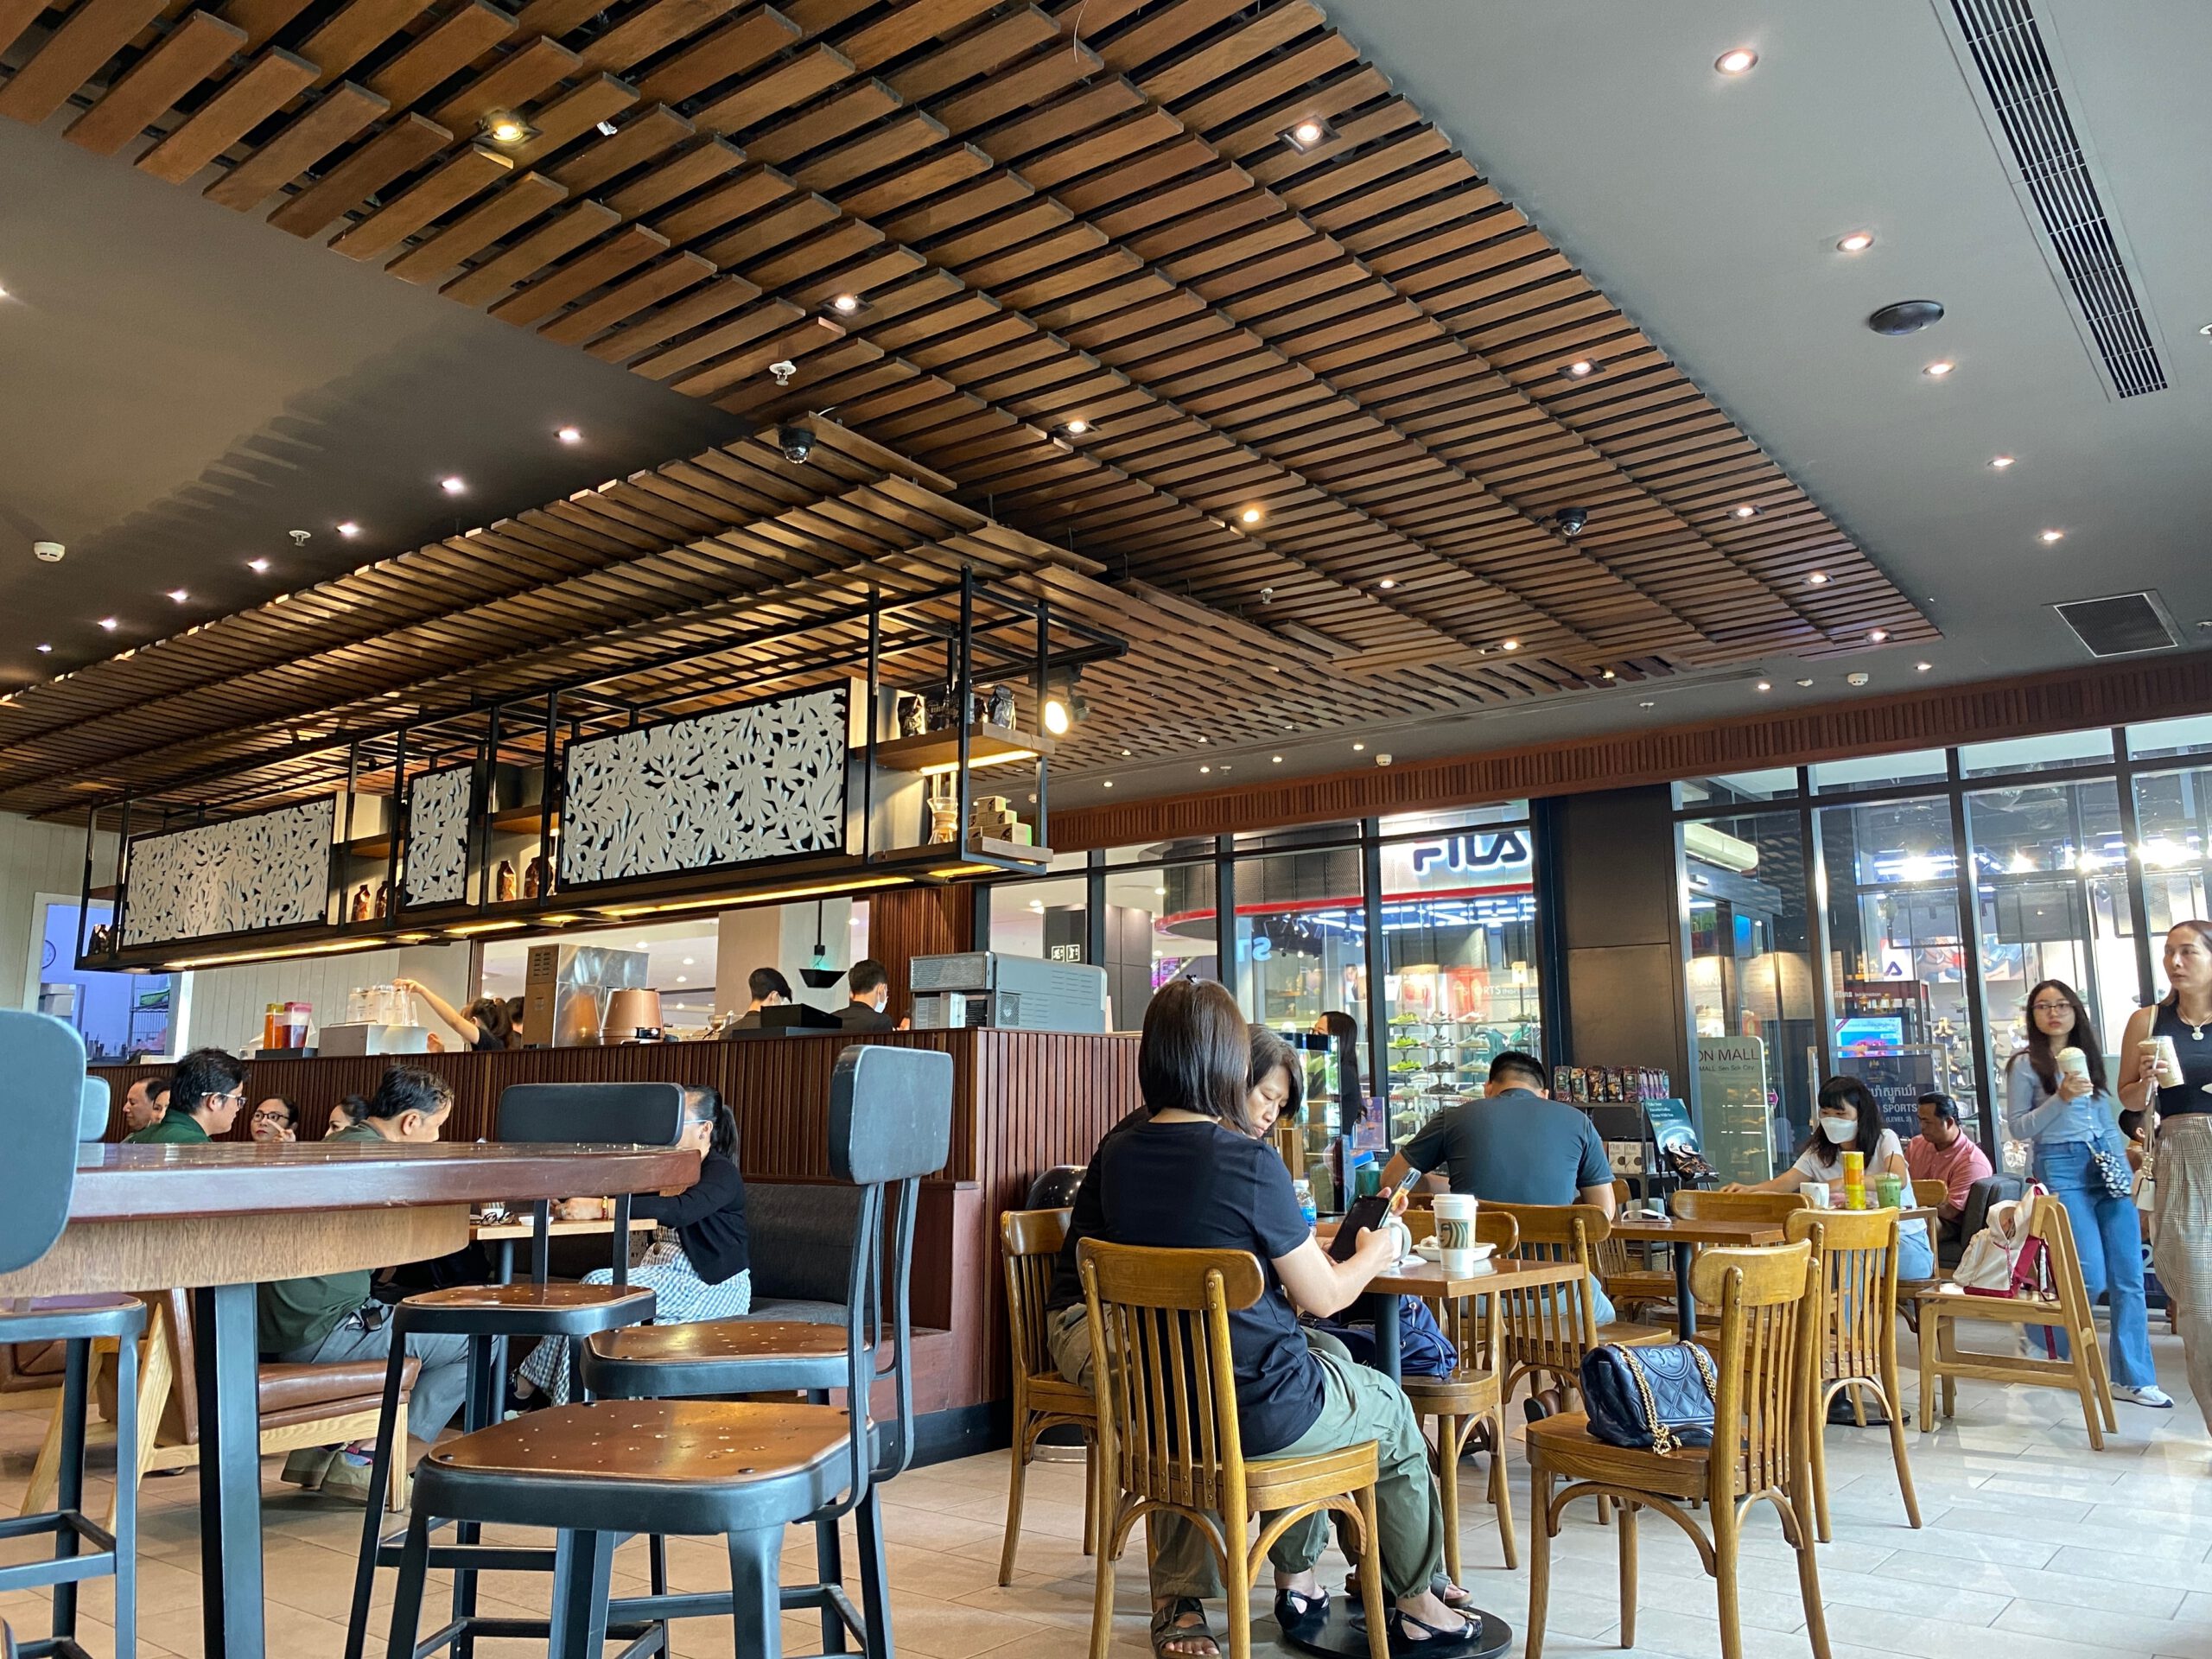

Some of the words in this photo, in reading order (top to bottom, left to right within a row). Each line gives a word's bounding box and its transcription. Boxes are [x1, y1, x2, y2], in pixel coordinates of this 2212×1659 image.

[1413, 831, 1528, 872] FILA
[1719, 1048, 1759, 1061] MALL
[1883, 1103, 1918, 1113] SPORTS
